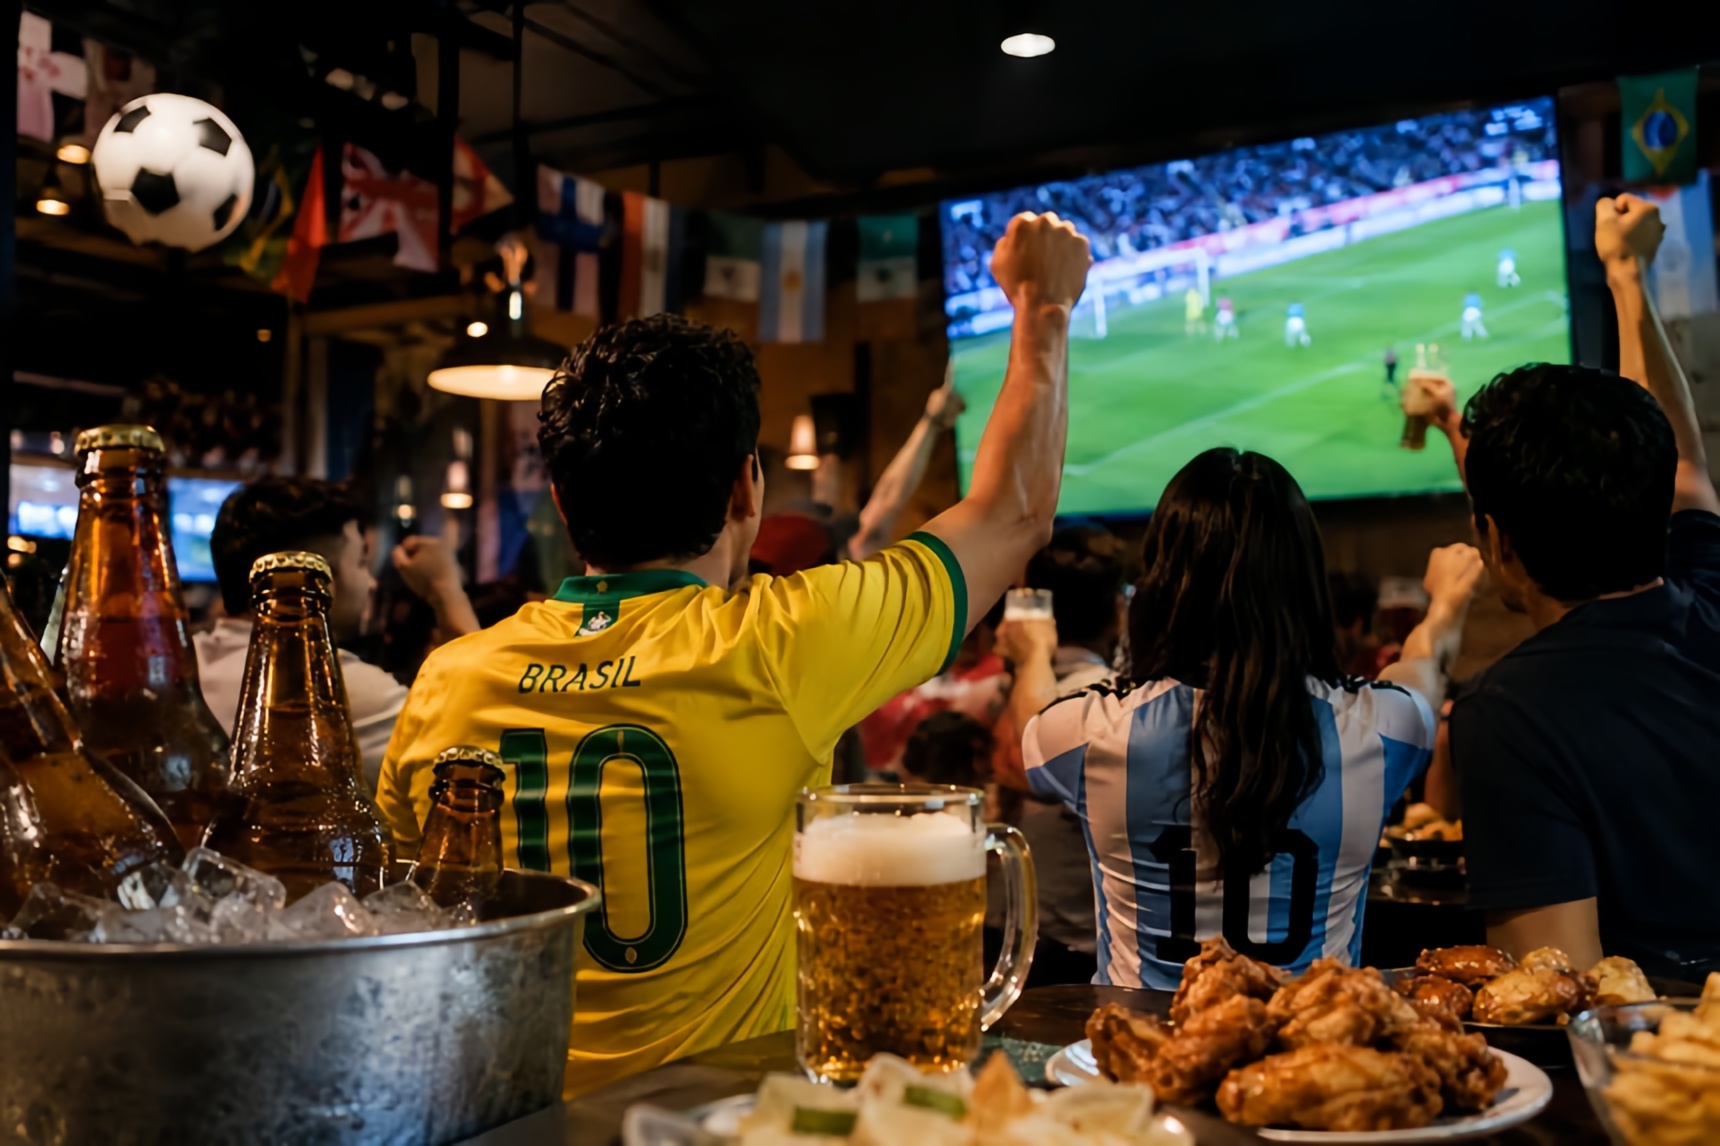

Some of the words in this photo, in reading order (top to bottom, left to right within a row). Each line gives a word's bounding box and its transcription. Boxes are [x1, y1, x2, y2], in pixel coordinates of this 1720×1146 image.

[518, 656, 641, 693] BRASIL
[500, 723, 688, 973] 10
[1150, 824, 1319, 966] 10
